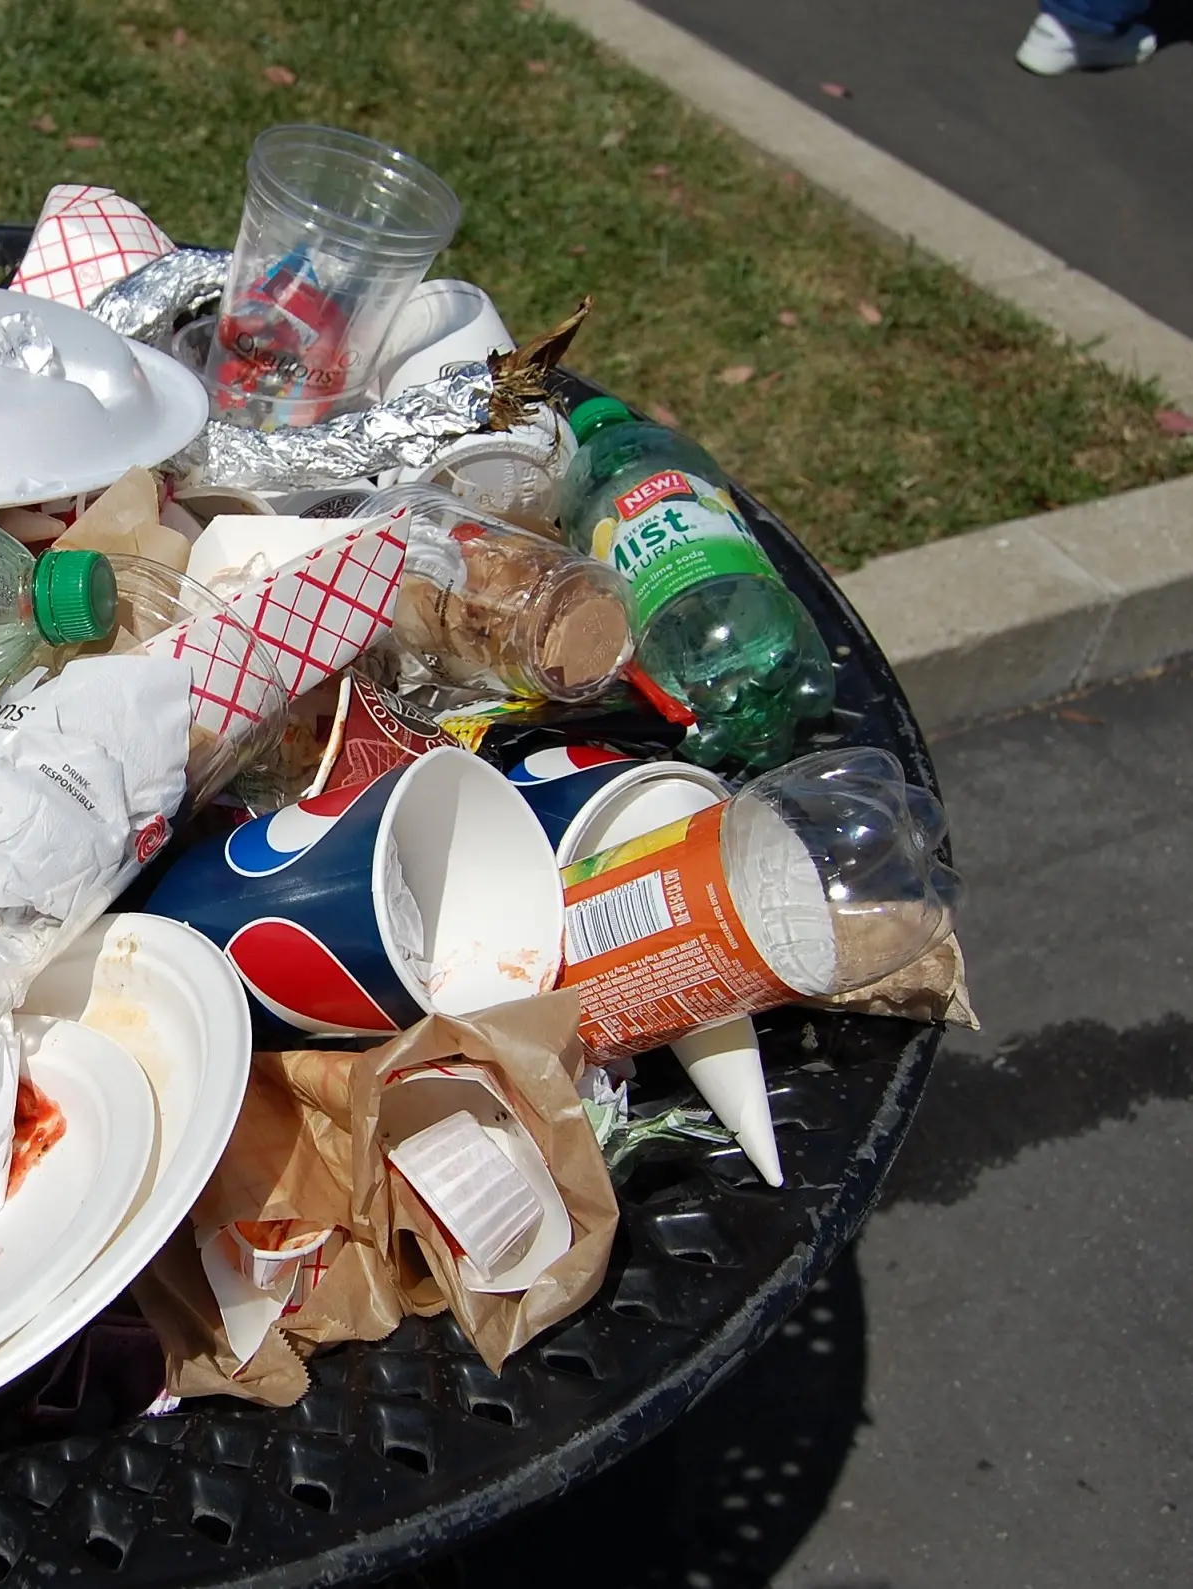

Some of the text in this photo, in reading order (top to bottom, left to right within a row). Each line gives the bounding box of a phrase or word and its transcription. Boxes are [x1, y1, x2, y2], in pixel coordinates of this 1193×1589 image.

[623, 474, 680, 509] NEW!
[623, 515, 660, 541] SIERRA
[625, 534, 696, 583] TURAL
[675, 549, 704, 565] soda
[39, 764, 95, 812] RESPONSIBLY
[61, 763, 91, 789] DRINK
[659, 867, 681, 885] CRV
[665, 881, 684, 895] CA
[574, 871, 660, 911] 0 12000 01269
[713, 904, 724, 921] AFTER
